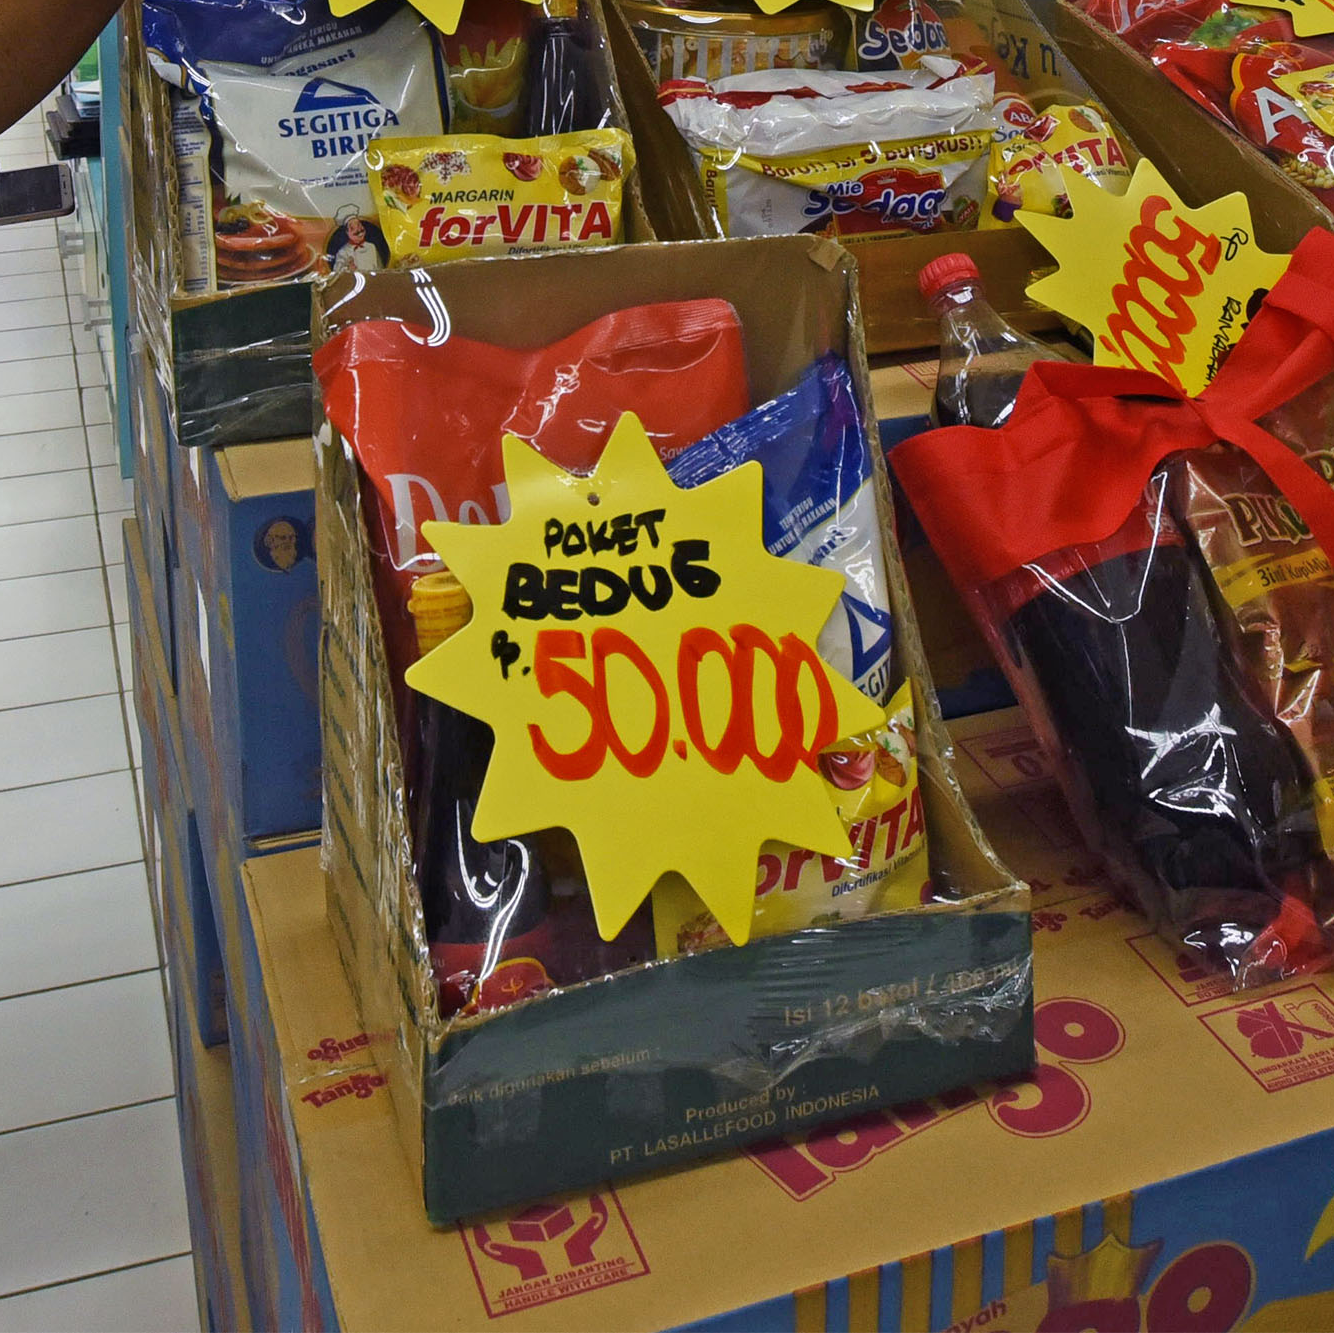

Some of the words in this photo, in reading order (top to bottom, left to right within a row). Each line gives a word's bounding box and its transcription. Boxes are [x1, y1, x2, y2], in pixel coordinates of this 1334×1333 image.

[277, 108, 400, 139] SEGITIGA
[429, 189, 515, 205] MARGARIN
[824, 180, 864, 198] Mie
[419, 201, 613, 248] forVITA
[502, 540, 722, 621] BEDUG
[755, 785, 926, 897] orVITA
[823, 995, 849, 1018] 12
[301, 1071, 388, 1109] Tango
[685, 1088, 771, 1123] Produced
[609, 1144, 635, 1165] PT
[643, 1108, 777, 1158] LASALLEFOOD
[784, 1083, 881, 1120] INDONESIA
[498, 1277, 552, 1300] JANGAN
[554, 1256, 628, 1283] DIBANTING
[558, 1278, 593, 1296] WITH
[593, 1267, 629, 1286] CARE
